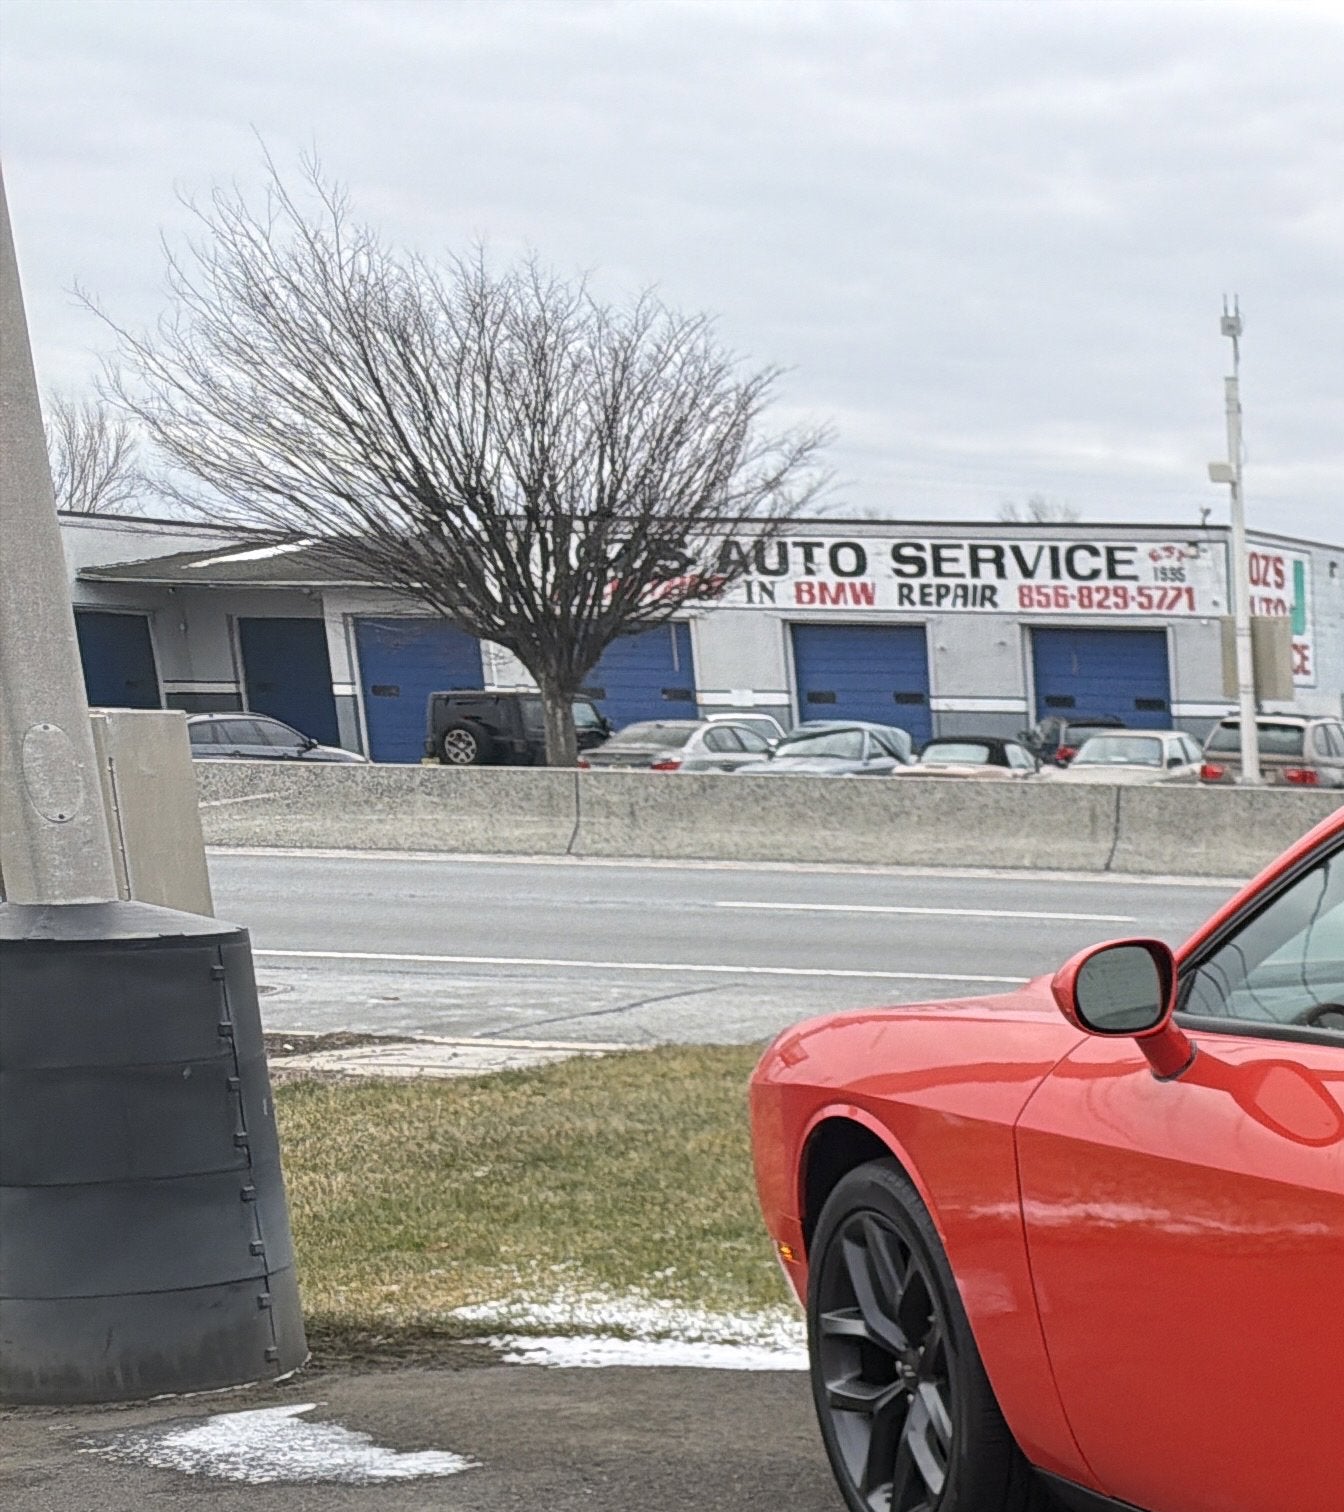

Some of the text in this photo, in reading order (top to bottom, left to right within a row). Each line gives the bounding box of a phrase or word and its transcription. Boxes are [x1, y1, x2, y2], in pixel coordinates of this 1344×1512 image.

[718, 541, 867, 578] AUTO
[891, 541, 1139, 581] SERVICE
[745, 580, 776, 605] IN
[794, 580, 875, 606] BMW
[897, 582, 998, 608] REPAIR
